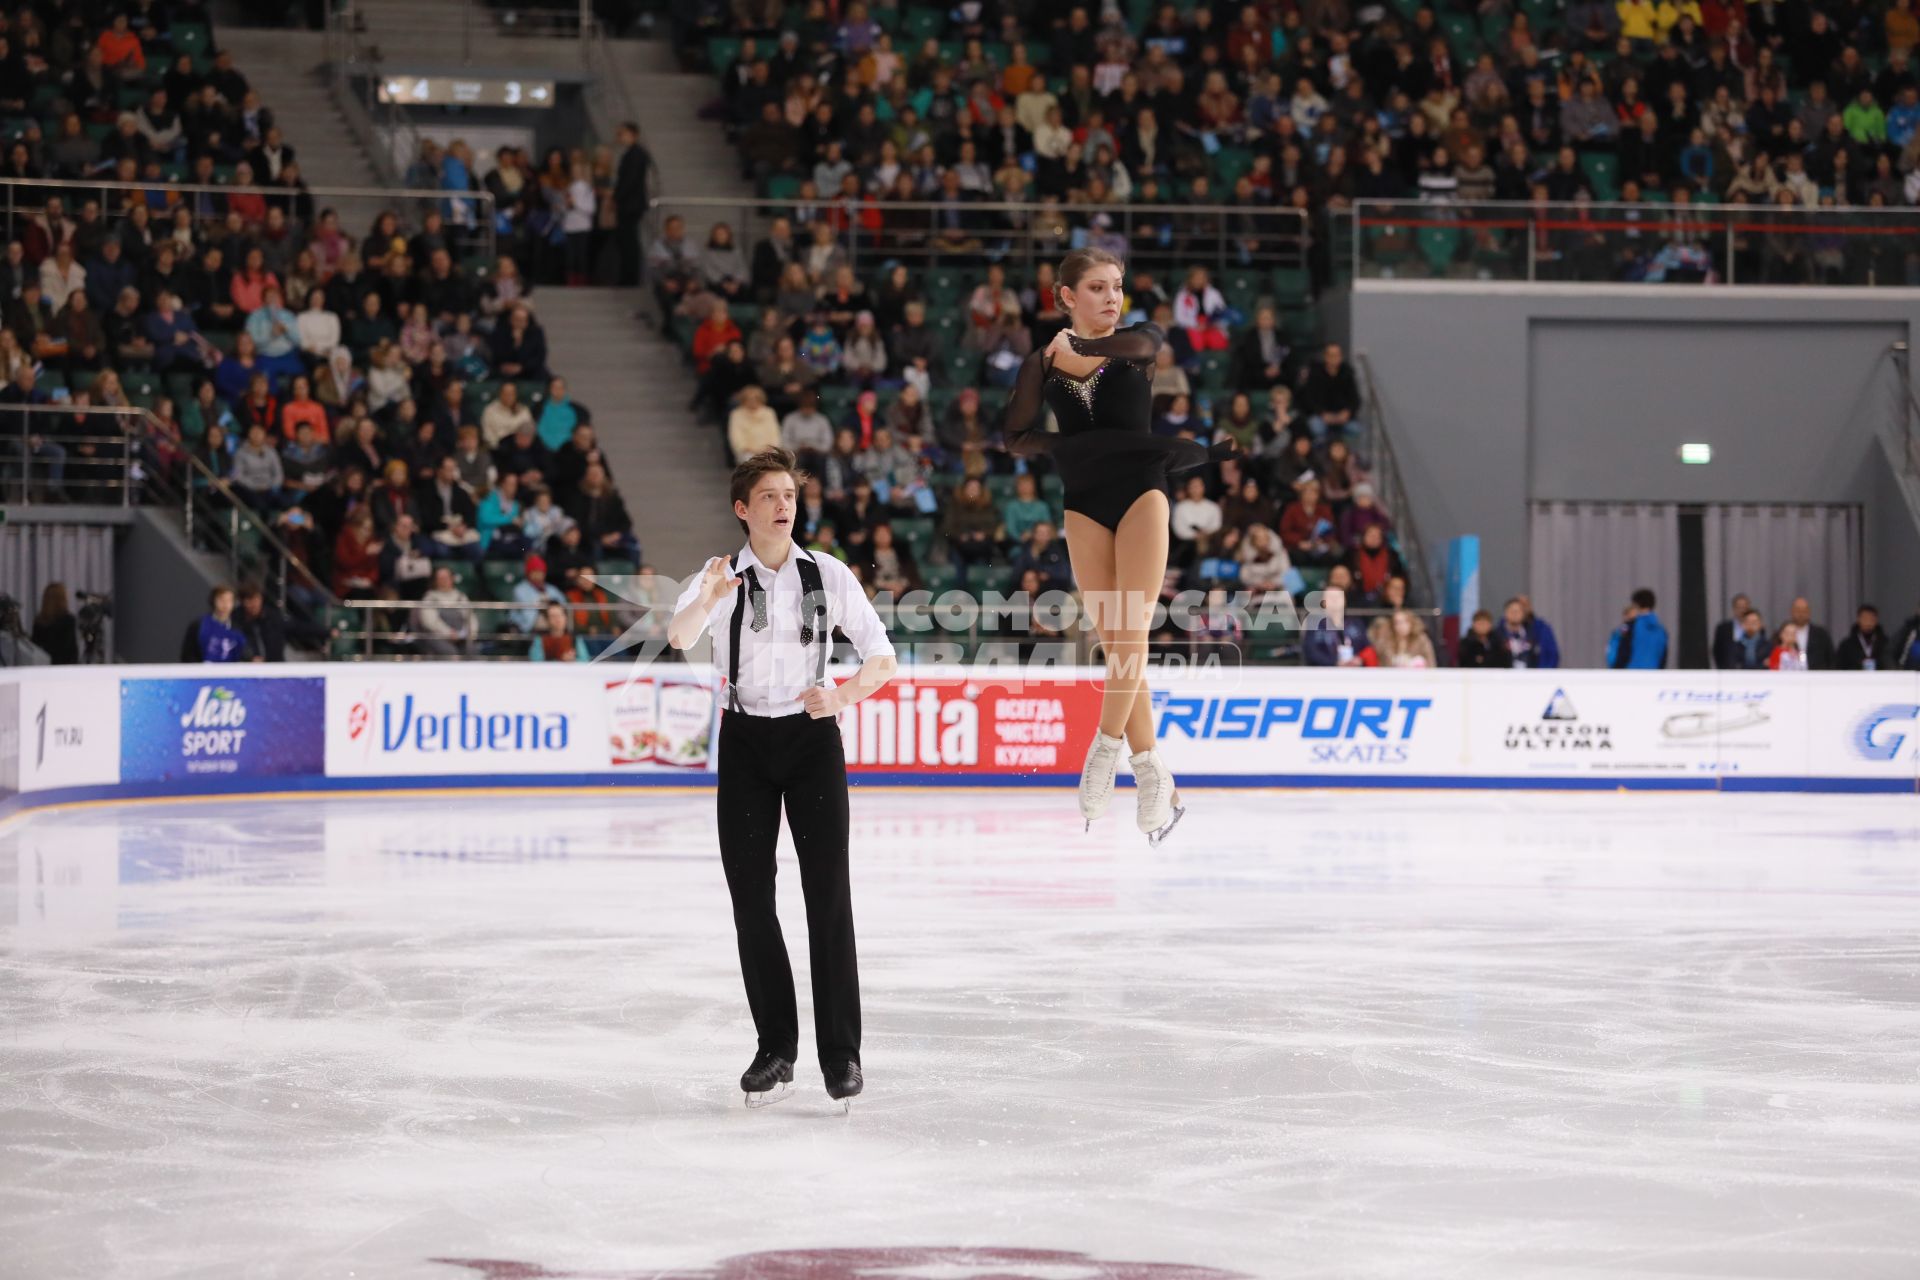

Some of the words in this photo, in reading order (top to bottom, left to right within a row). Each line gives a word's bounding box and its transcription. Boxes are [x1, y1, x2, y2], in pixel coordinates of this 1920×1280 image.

[411, 79, 429, 101] 4
[504, 81, 522, 104] 3
[995, 699, 1065, 723] ВСЕГДА
[1156, 698, 1433, 739] RISPORT
[382, 694, 570, 753] Verbena
[838, 683, 980, 766] anita
[995, 722, 1066, 743] ЧИСТАЯ
[1507, 726, 1611, 735] JACKSON
[182, 730, 247, 757] SPORT
[1310, 743, 1408, 764] SKATES
[1504, 738, 1613, 750] ULTIMA
